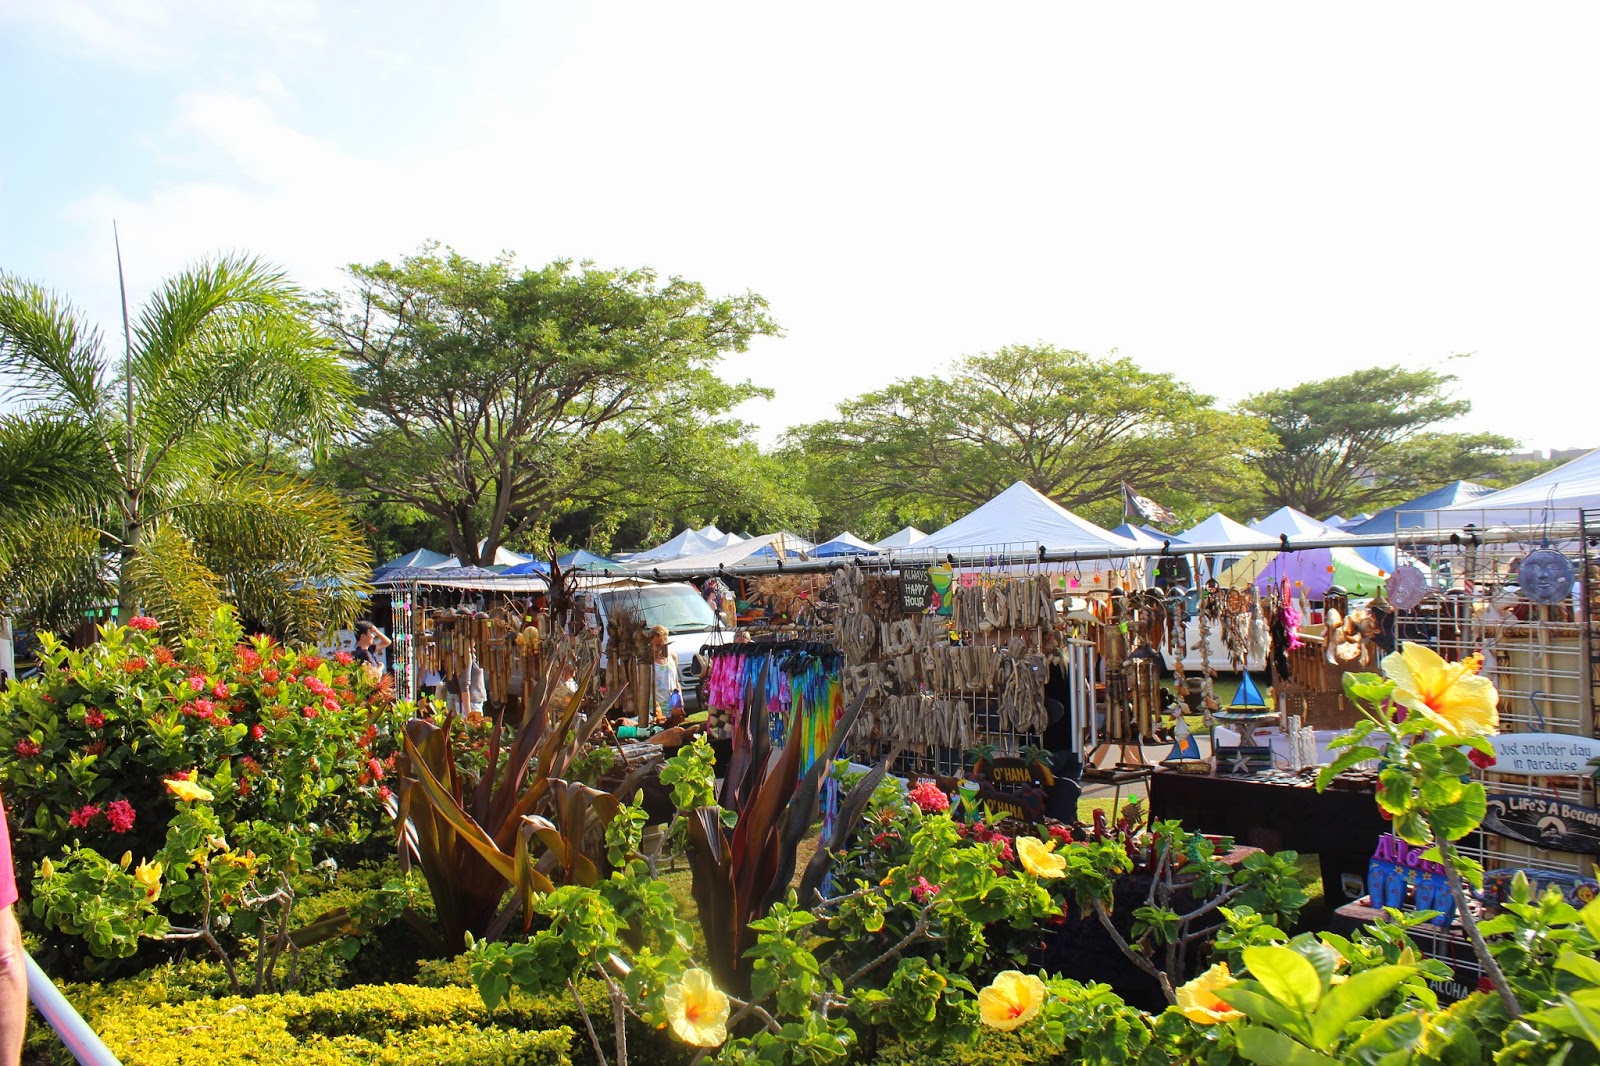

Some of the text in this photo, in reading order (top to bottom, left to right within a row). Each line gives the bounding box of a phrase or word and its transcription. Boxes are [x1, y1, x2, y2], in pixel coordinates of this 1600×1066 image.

[904, 570, 929, 582] ALWAYS
[905, 583, 929, 596] HAPPY
[903, 595, 925, 608] HOUR
[1500, 742, 1592, 761] Just another day
[1513, 757, 1523, 769] in
[993, 767, 1032, 782] O'HANA
[1548, 802, 1559, 816] A
[1429, 980, 1469, 1000] ALOHA
